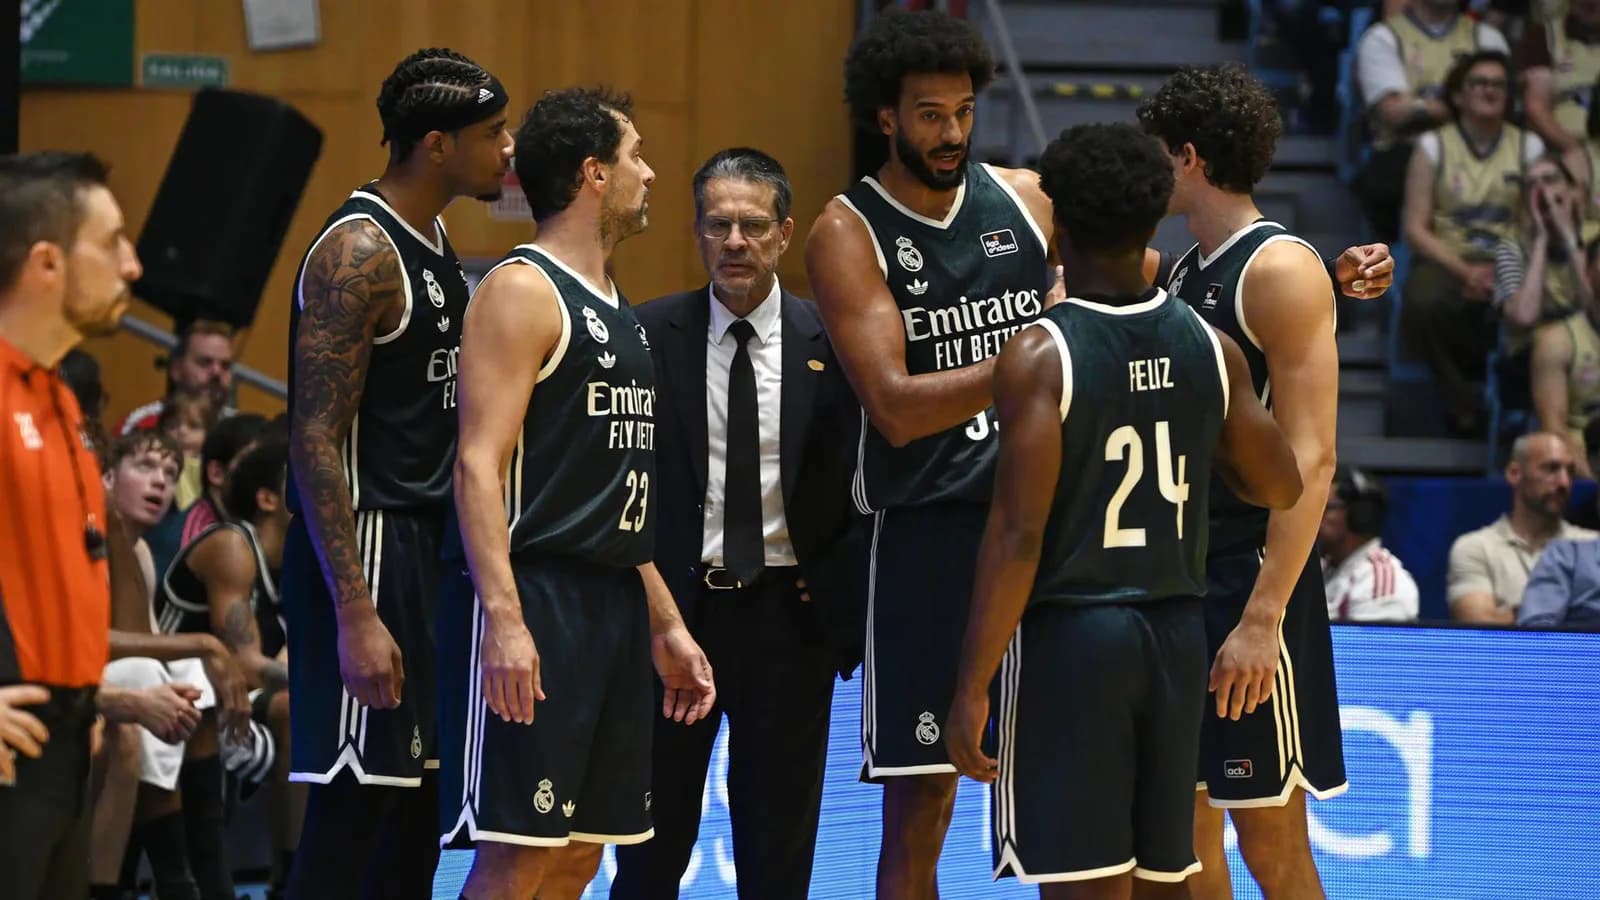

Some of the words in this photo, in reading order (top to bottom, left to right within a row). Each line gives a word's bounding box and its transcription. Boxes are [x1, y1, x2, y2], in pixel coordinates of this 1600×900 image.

[901, 289, 1042, 342] Emirates
[935, 338, 963, 370] FLY
[1128, 357, 1174, 392] FELIZ
[608, 420, 634, 449] FLY
[618, 469, 649, 533] 23
[1103, 420, 1190, 549] 24
[1227, 766, 1246, 776] acb
